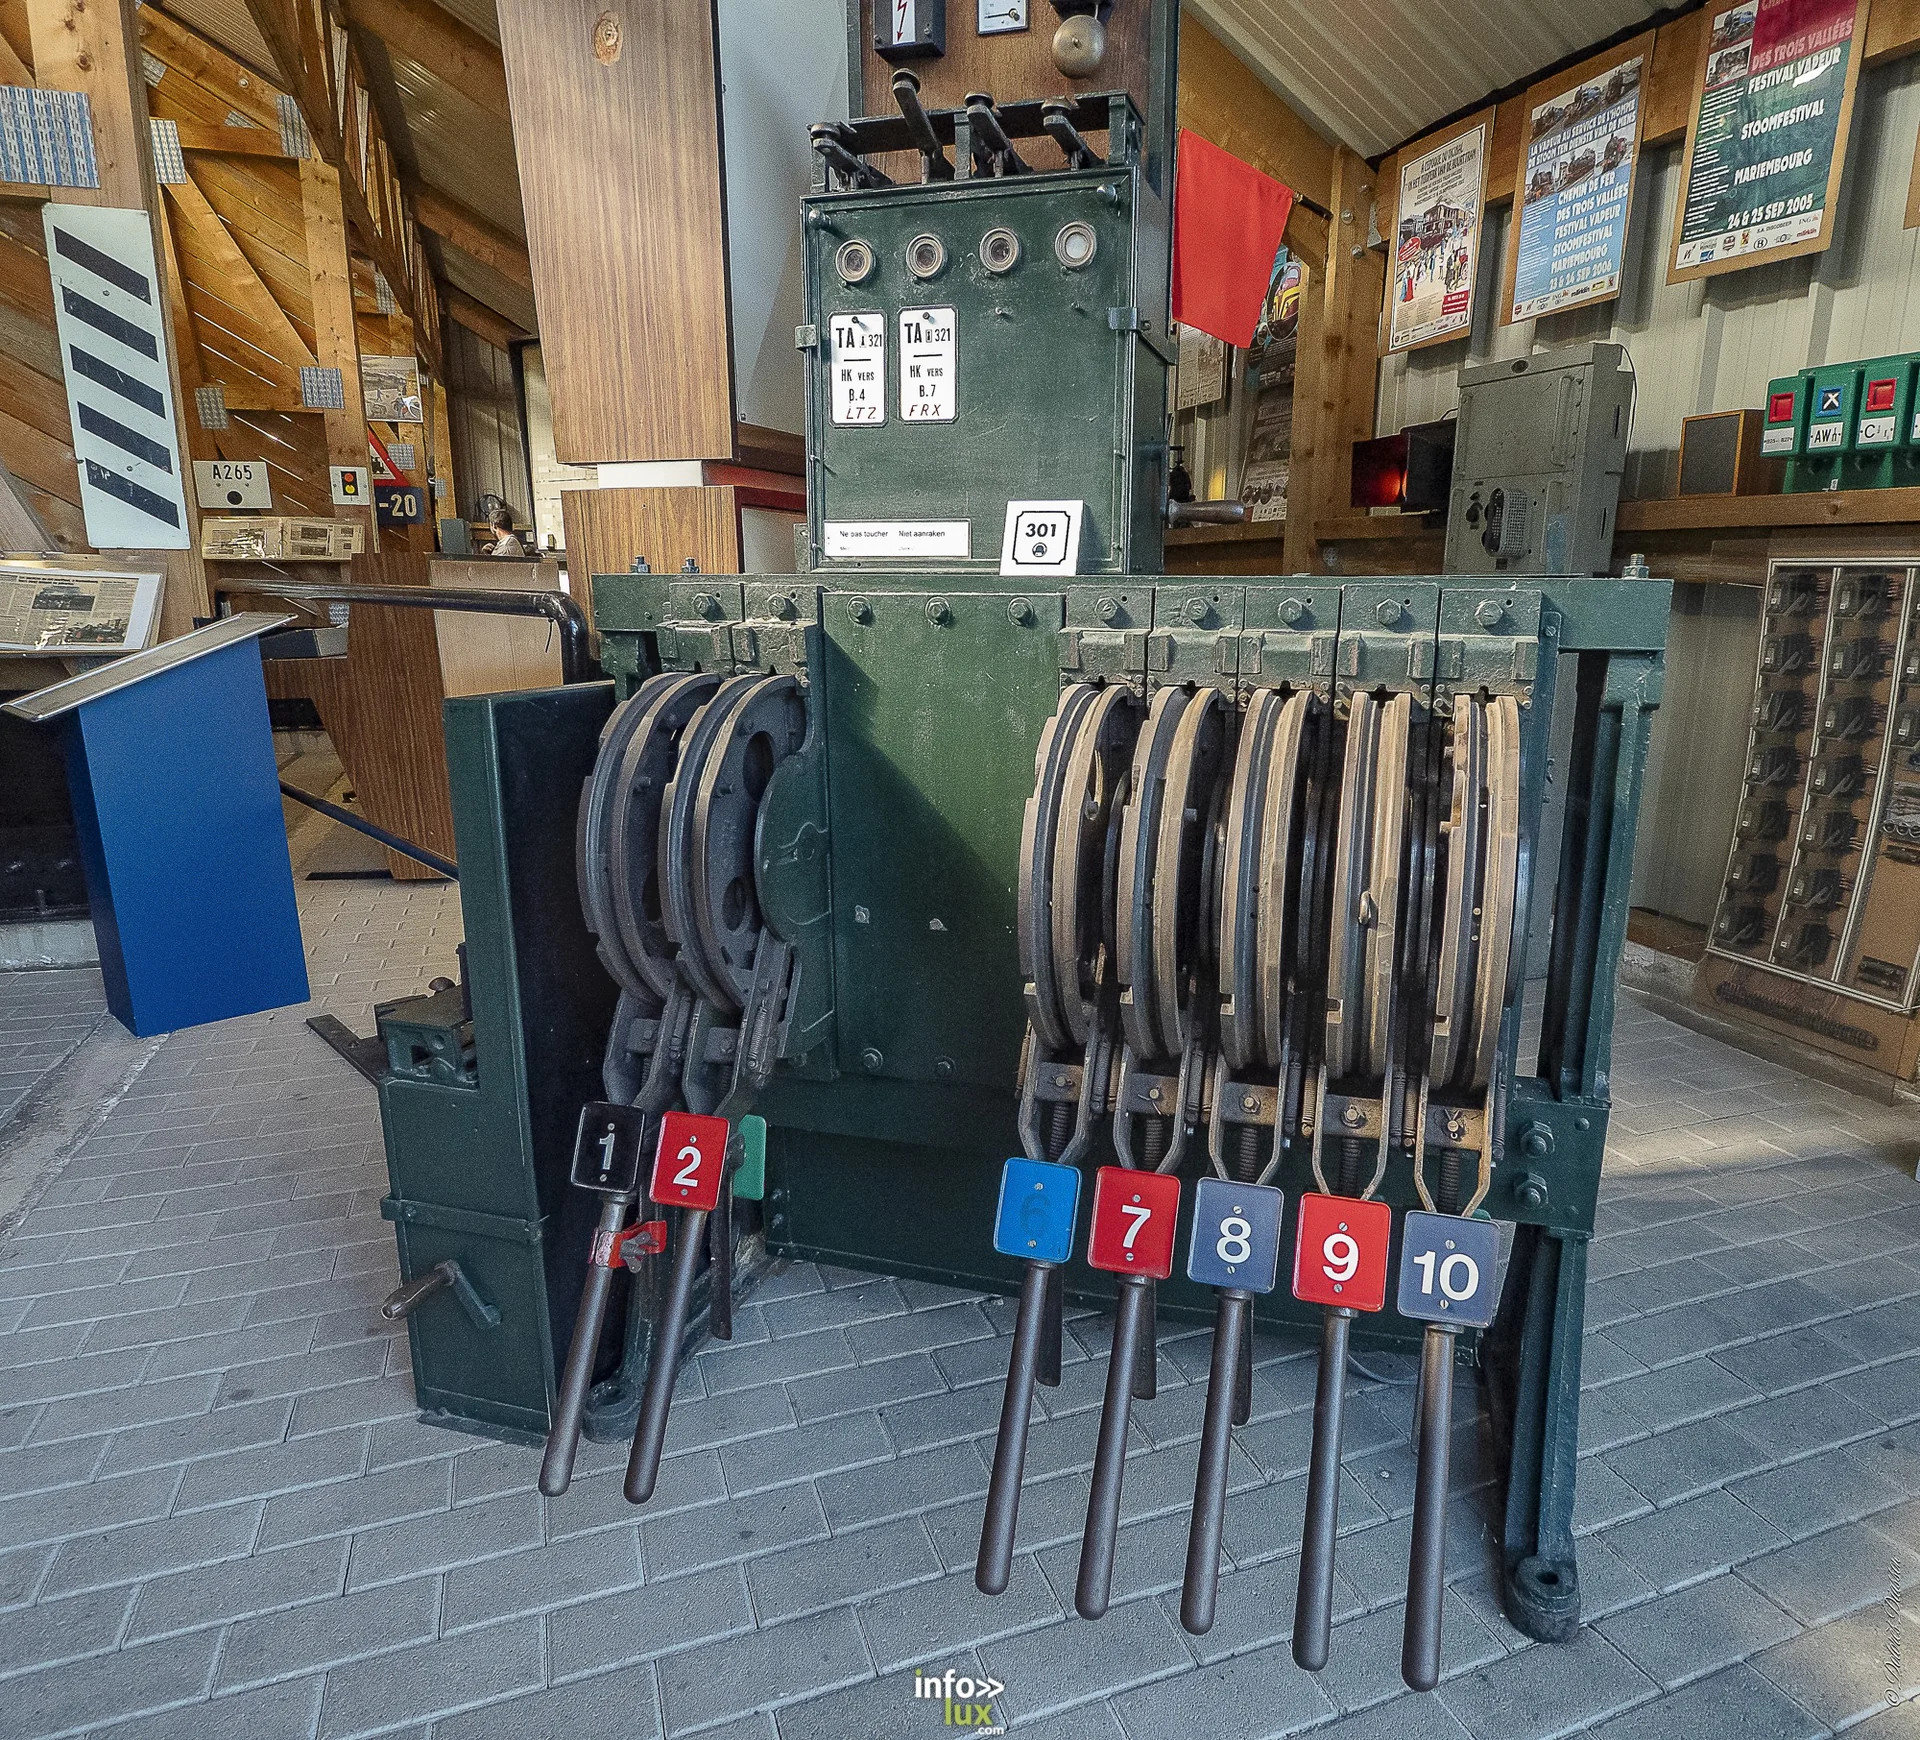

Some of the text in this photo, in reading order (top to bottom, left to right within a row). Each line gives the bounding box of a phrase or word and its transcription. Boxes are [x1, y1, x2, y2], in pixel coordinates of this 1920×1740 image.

[1751, 17, 1853, 72] DES TROIS VALLÉES
[1748, 66, 1795, 95] FESTIVAL
[1563, 130, 1571, 143] AU
[1572, 119, 1597, 139] SERVICE
[1594, 126, 1608, 143] VAN
[1740, 98, 1825, 140] STOOMFESTIVAL
[1733, 148, 1813, 186] MARIEMBOURG
[1556, 207, 1571, 223] DES
[1571, 198, 1594, 218] TROIS
[1595, 181, 1629, 207] VALLÉES
[1558, 171, 1615, 205] CHEMIN DE FER
[1554, 217, 1588, 240] FESTIVAL
[1589, 203, 1621, 227] VAPEUR
[1727, 213, 1741, 230] 24
[1751, 207, 1764, 223] 25
[1764, 200, 1786, 221] SEP
[1786, 193, 1813, 215] 2005
[1798, 217, 1812, 226] ING
[1552, 223, 1613, 257] STOOMFESTIVAL
[1551, 243, 1608, 274] MARIEMBOURG
[1577, 266, 1591, 283] SEP
[1592, 259, 1612, 277] 2006
[836, 327, 882, 348] TA 321
[904, 323, 951, 343] TA 321
[841, 369, 875, 382] HK VERS
[910, 365, 943, 378] HK VERS
[849, 389, 865, 401] B.4
[919, 385, 936, 397] B.7
[909, 404, 942, 417] FRX
[213, 464, 253, 480] A265
[379, 494, 417, 517] -20
[1025, 523, 1057, 538] 301
[599, 1133, 615, 1170] 1
[673, 1146, 702, 1187] 2
[1020, 1192, 1049, 1237] 6
[1121, 1204, 1151, 1249] 7
[1216, 1217, 1251, 1263] 8
[1322, 1233, 1359, 1281] 9
[1413, 1251, 1479, 1300] 10
